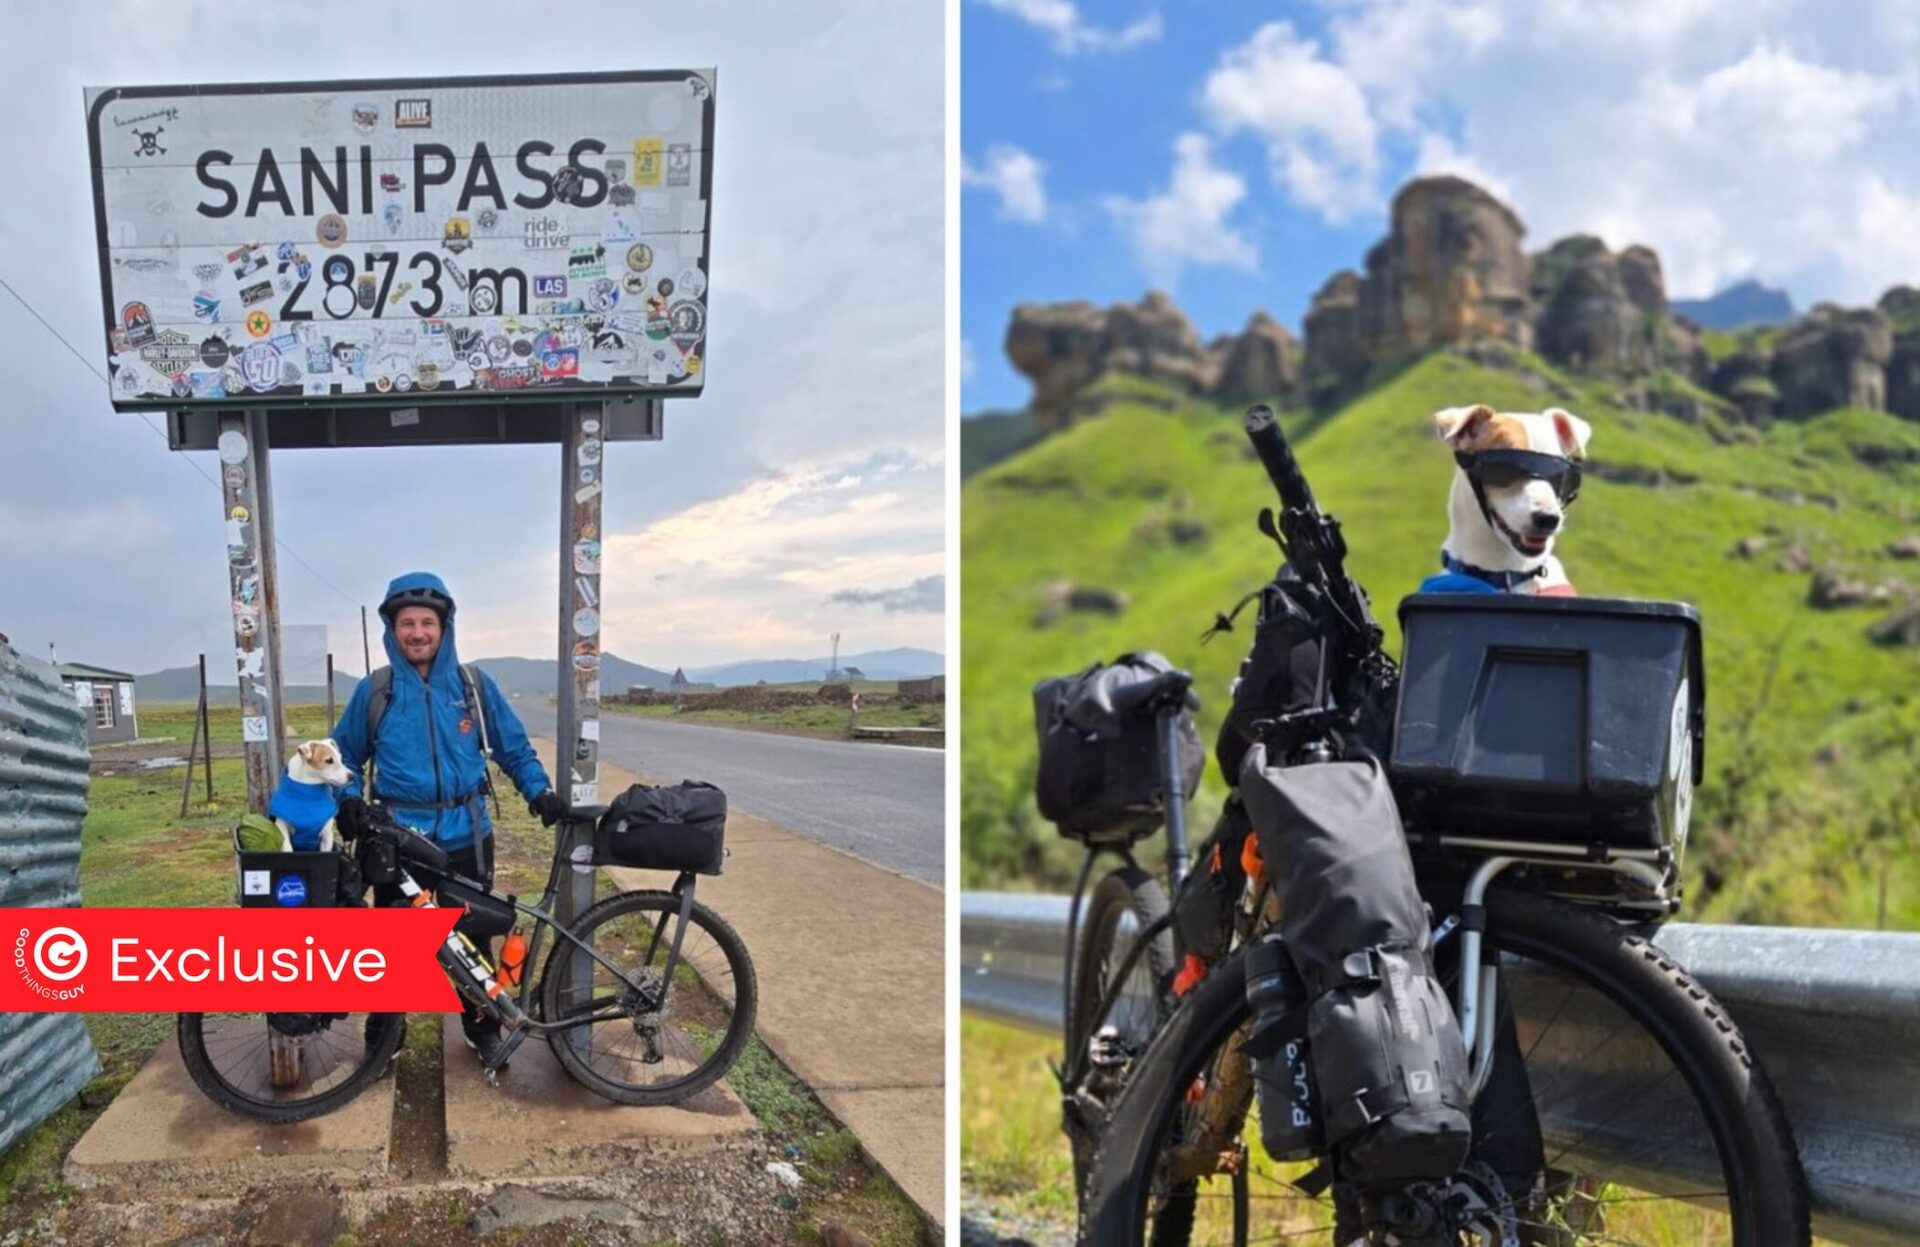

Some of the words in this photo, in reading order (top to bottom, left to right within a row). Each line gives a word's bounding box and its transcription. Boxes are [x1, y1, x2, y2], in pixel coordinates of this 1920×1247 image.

[196, 144, 374, 218] SANI
[413, 138, 609, 213] PASS
[524, 216, 559, 232] ride
[524, 232, 570, 248] drive
[277, 251, 443, 321] 2873
[468, 267, 528, 316] m
[536, 277, 563, 295] LAS
